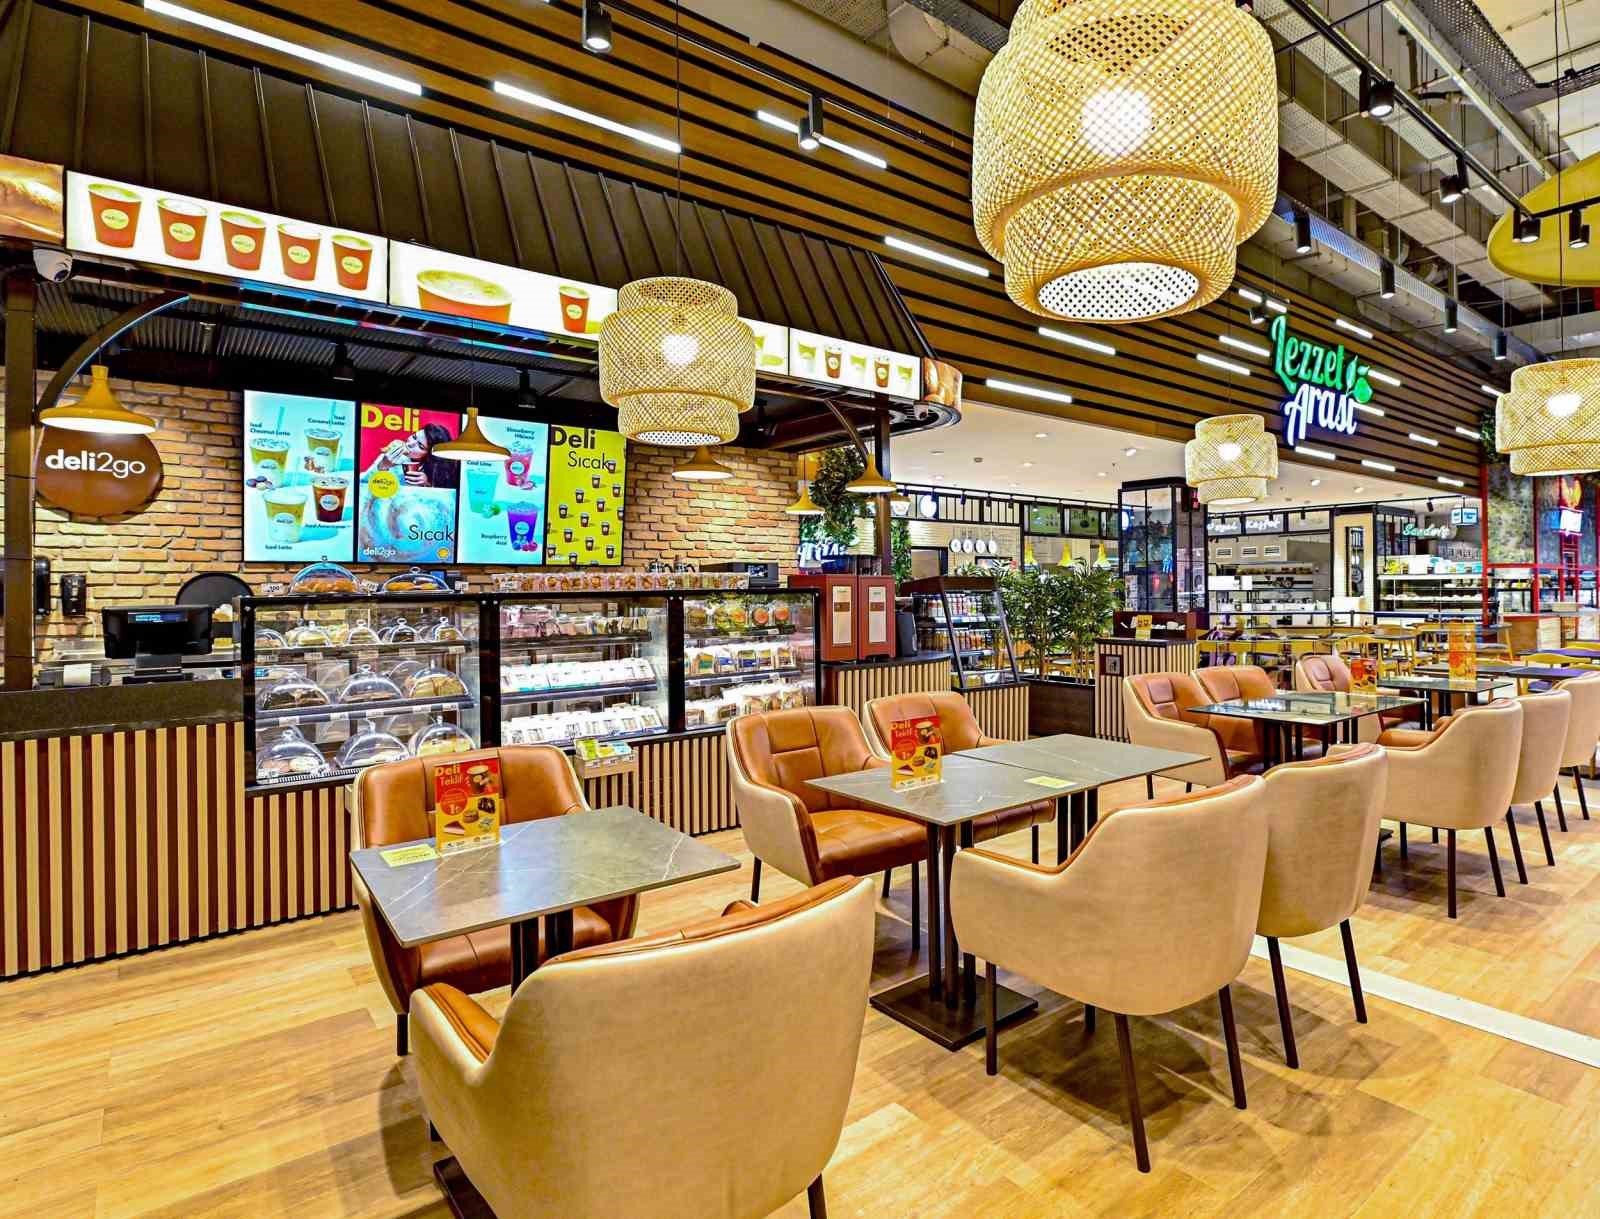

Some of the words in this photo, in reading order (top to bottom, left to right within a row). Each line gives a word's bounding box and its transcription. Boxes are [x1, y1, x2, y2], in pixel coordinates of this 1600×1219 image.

[361, 403, 420, 432] Deli
[551, 427, 596, 449] Deli
[45, 449, 146, 478] deli2go
[363, 547, 396, 558] deli2go
[435, 765, 461, 777] Deli
